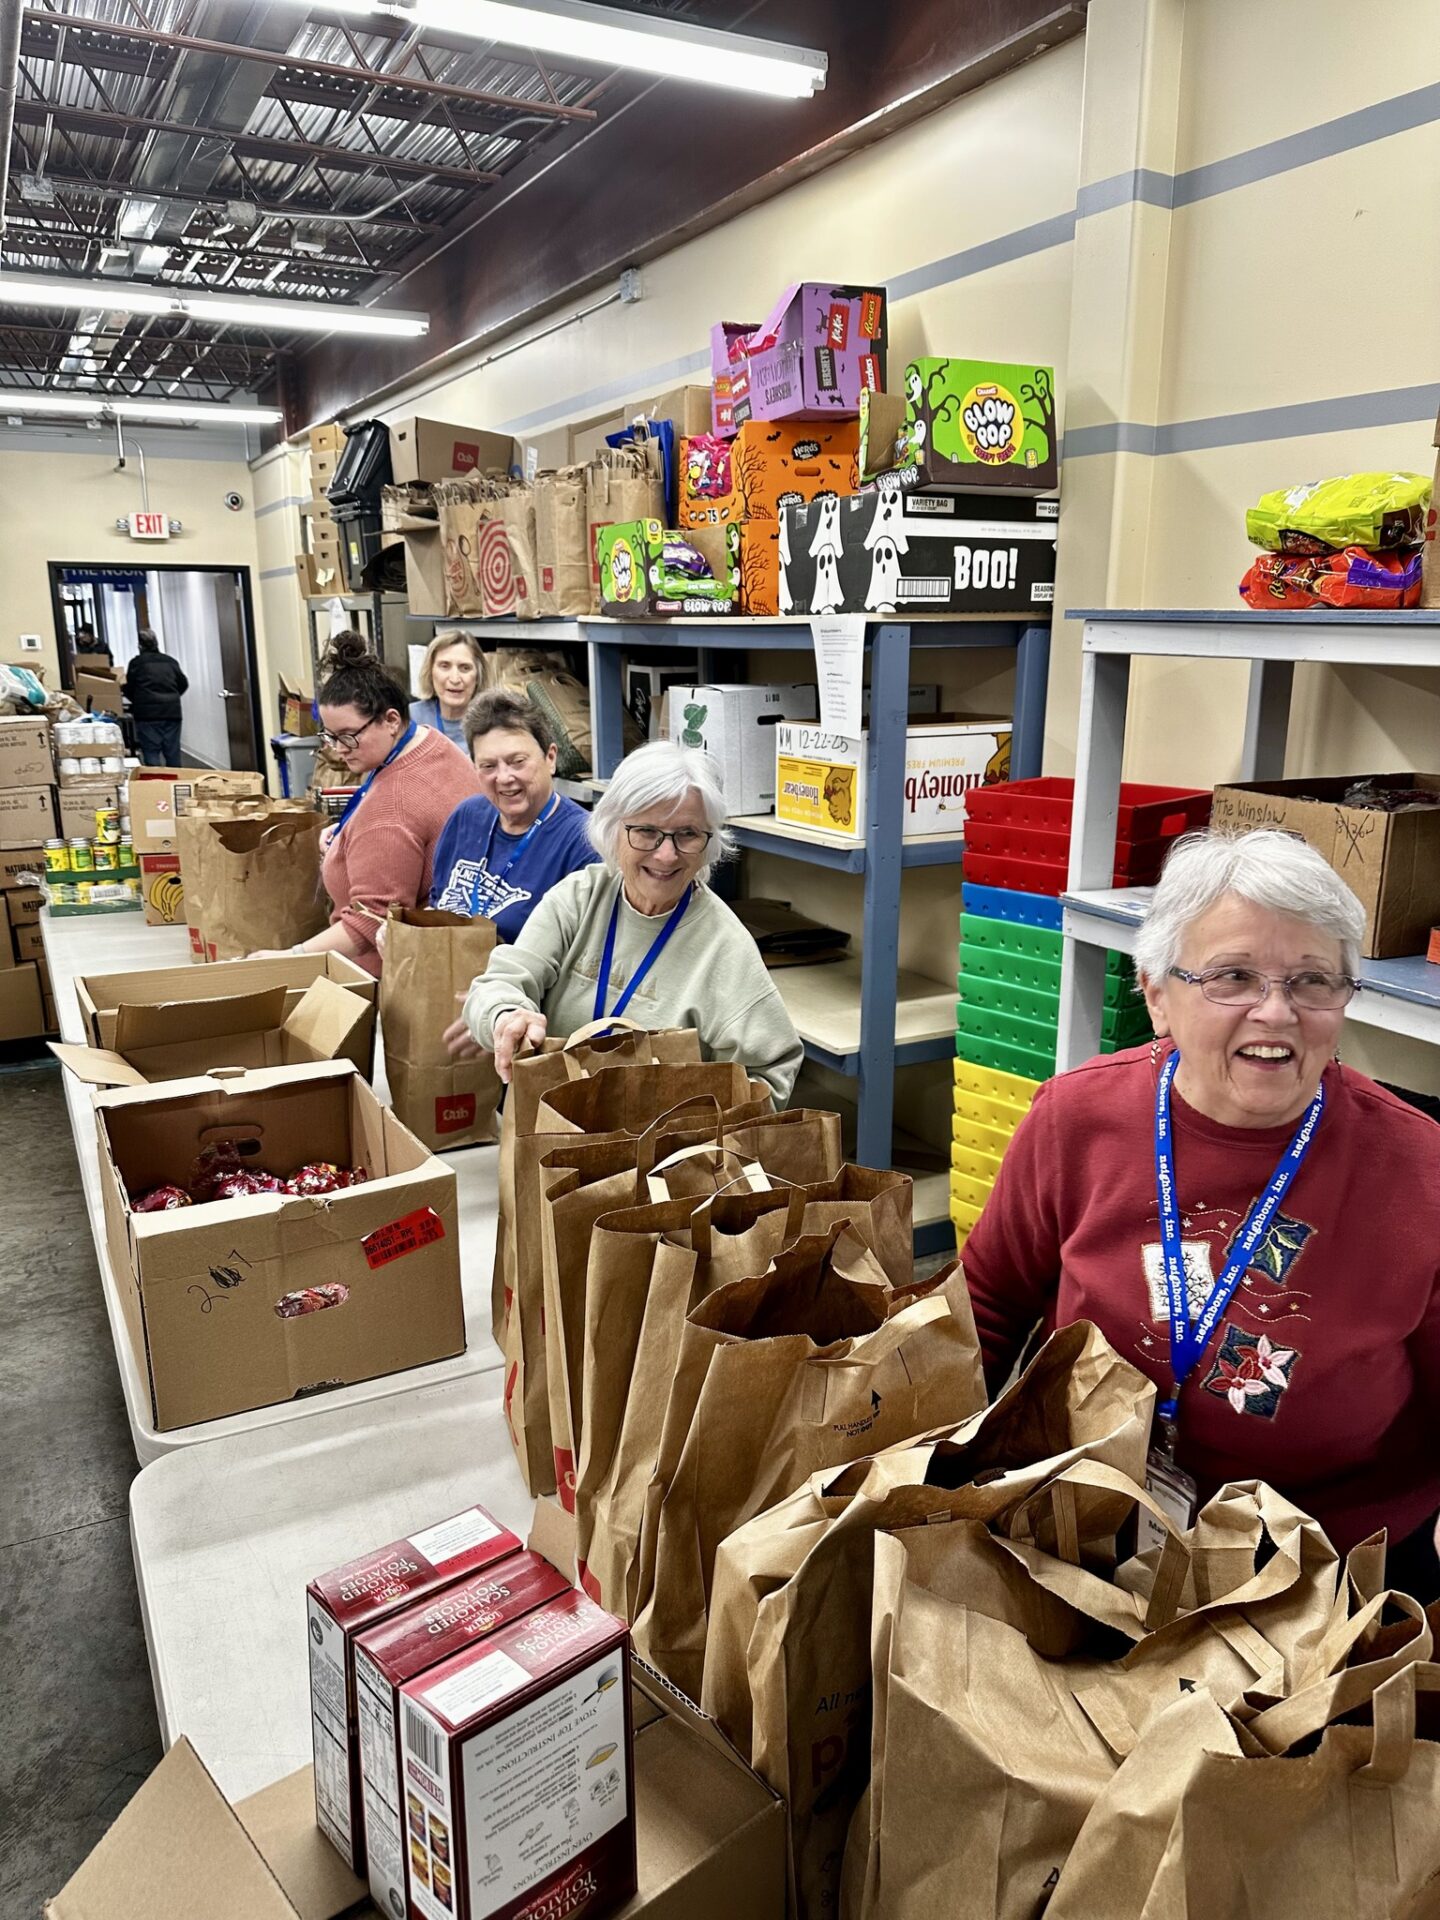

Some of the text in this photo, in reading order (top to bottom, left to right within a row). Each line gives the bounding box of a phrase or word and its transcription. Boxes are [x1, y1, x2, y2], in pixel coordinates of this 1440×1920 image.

[964, 398, 1015, 432] BLOW
[976, 424, 1013, 449] POP
[877, 471, 901, 491] BLOW
[707, 510, 718, 523] 75
[912, 498, 948, 507] VARIETY BAG
[136, 514, 163, 534] EXIT
[954, 545, 1018, 590] BOO!
[684, 598, 732, 613] BLOW POP
[1034, 584, 1054, 593] SEASON
[907, 757, 966, 769] PREMIUM FRES
[783, 782, 819, 806] Honeybear
[904, 769, 981, 814] oneyb
[1216, 799, 1234, 817] The
[1237, 803, 1287, 825] Winslow
[442, 1107, 469, 1121] Cub
[1157, 1061, 1173, 1140] neighbors, inc.
[1291, 1102, 1323, 1158] neighbors,
[1159, 1154, 1176, 1242] neighbors, inc.
[1242, 1171, 1290, 1251] neighbors, inc.
[1168, 1255, 1185, 1343] neighbors, inc.
[1195, 1263, 1241, 1344] neighbors, inc.
[846, 1422, 873, 1438] NOT OUT
[339, 1558, 408, 1593] POTATOES
[341, 1561, 418, 1601] SCALLOPED
[425, 1582, 498, 1625] POTATOES
[428, 1586, 511, 1634] SCALLOPED
[515, 1608, 588, 1651] SCALLOPED
[815, 1692, 838, 1716] All
[496, 1706, 598, 1775] STOVE TOP INSTRUCTIONS
[568, 1832, 593, 1853] OVEN
[512, 1848, 571, 1892] INSTRUCTIONS
[544, 1879, 598, 1920] SCALLO
